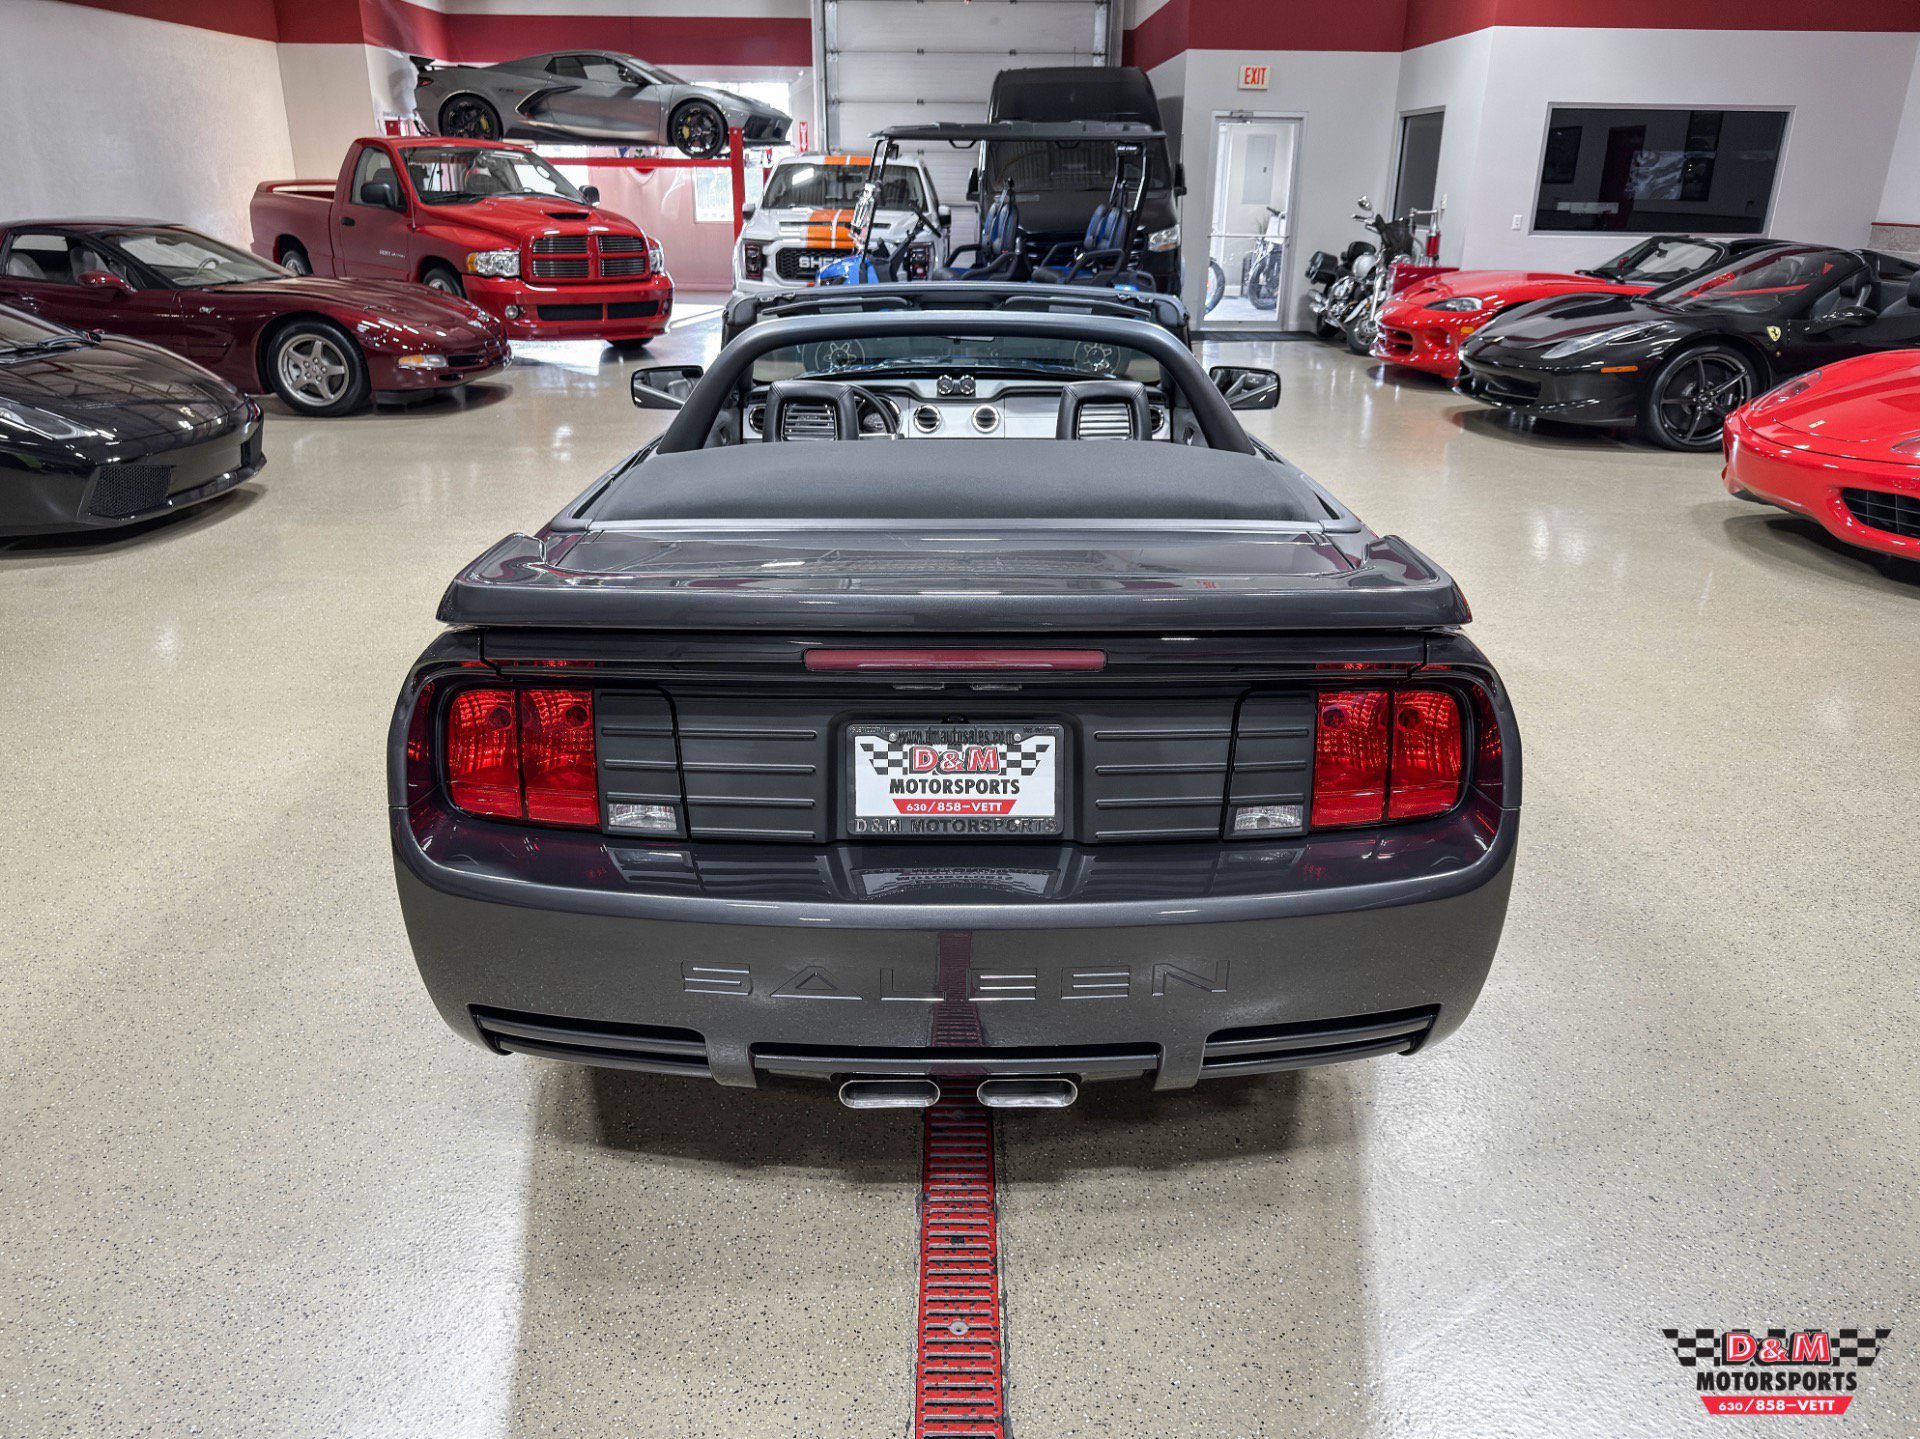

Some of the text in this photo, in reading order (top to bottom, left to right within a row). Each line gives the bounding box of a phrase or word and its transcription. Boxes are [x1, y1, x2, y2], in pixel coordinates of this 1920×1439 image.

[1244, 66, 1267, 85] EXIT
[910, 745, 1001, 775] D&M
[889, 778, 1021, 795] MOTORSPORTS
[911, 818, 1058, 833] MOTORSPORTS
[680, 959, 1230, 1001] SALEEN
